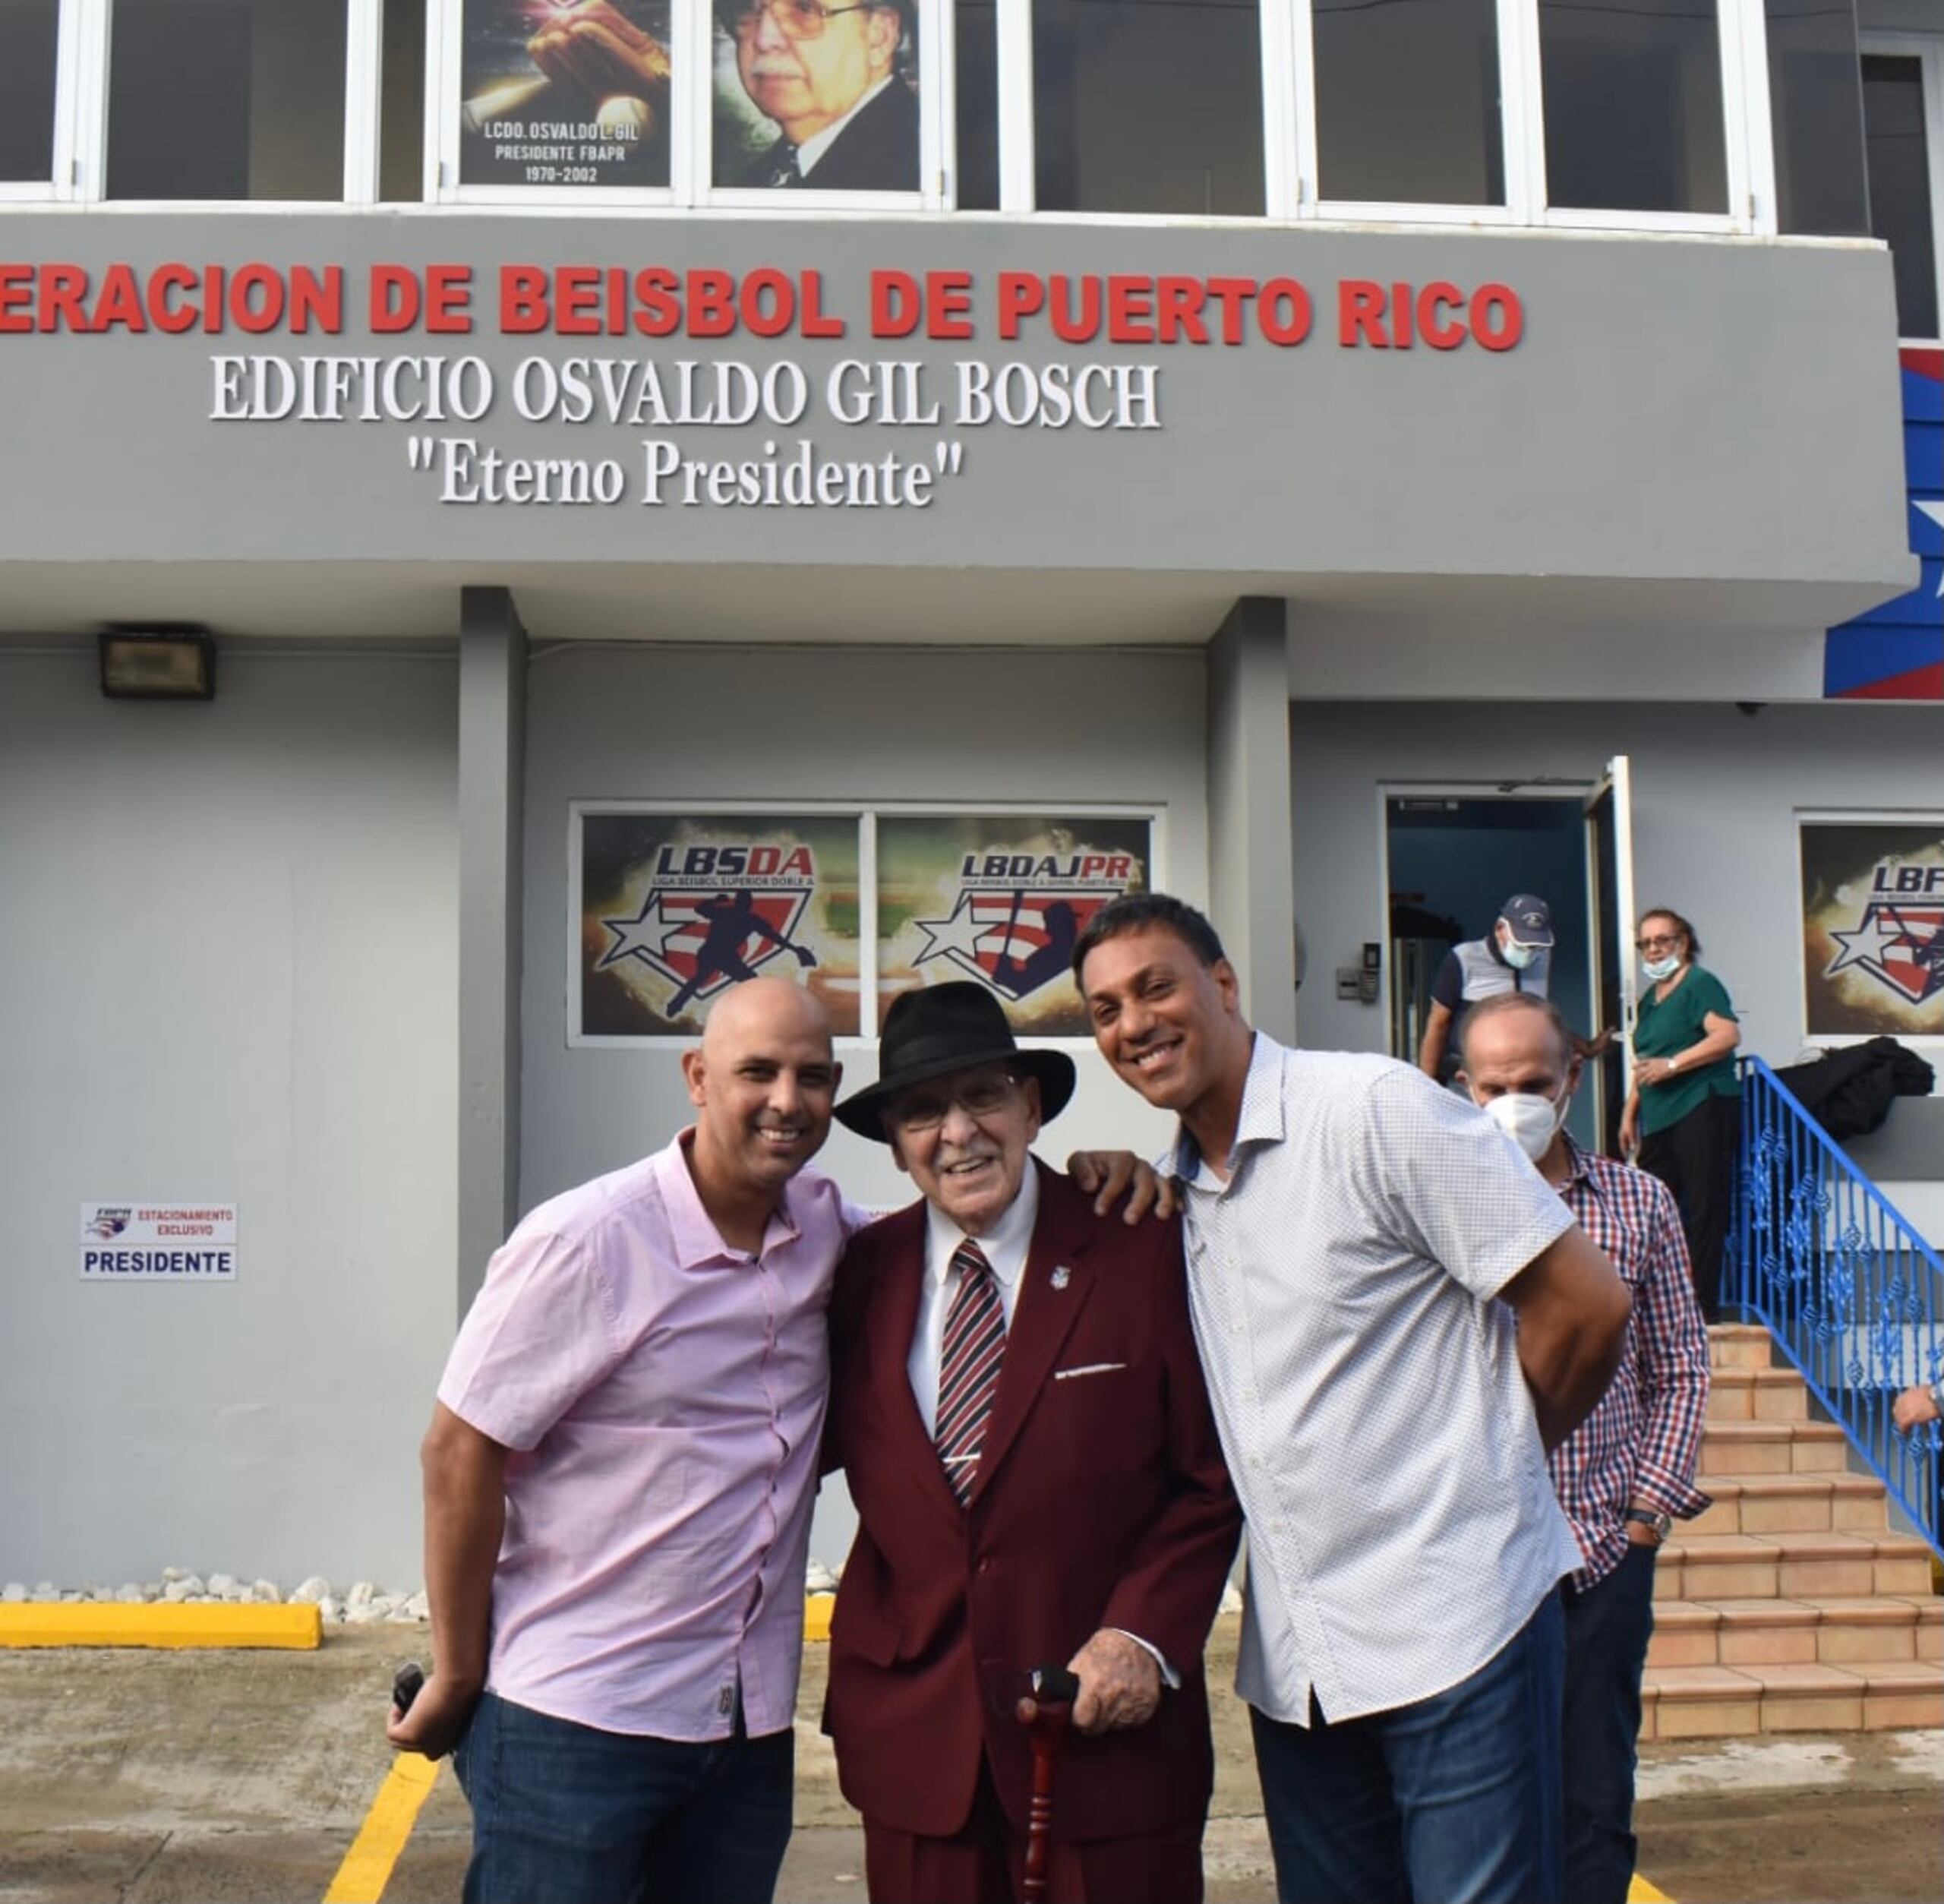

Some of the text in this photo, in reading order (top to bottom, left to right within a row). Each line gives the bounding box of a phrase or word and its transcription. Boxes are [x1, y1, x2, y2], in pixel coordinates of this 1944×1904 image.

[484, 122, 528, 139] LCDO.
[529, 122, 600, 141] OSVALDO
[614, 125, 639, 141] GIL
[494, 144, 626, 162] PRESIDENTE FBAPR
[525, 166, 598, 183] 1970-2002
[0, 263, 1523, 352] ERACION DE BEISBOL DE PUERTO RICO
[208, 354, 1162, 430] EDIFICIO OSVALDO GIL BOSCH
[407, 435, 963, 508] "Eterno Presidente"
[657, 846, 815, 875] LBSDA
[961, 855, 1131, 879] LBDAJPR
[721, 876, 769, 886] SUPERIOR
[772, 876, 805, 886] DOBLE
[137, 1209, 233, 1221] ESTACIONAMIENTO
[157, 1224, 213, 1236] EXCLUSIVO
[84, 1251, 231, 1273] PRESIDENTE
